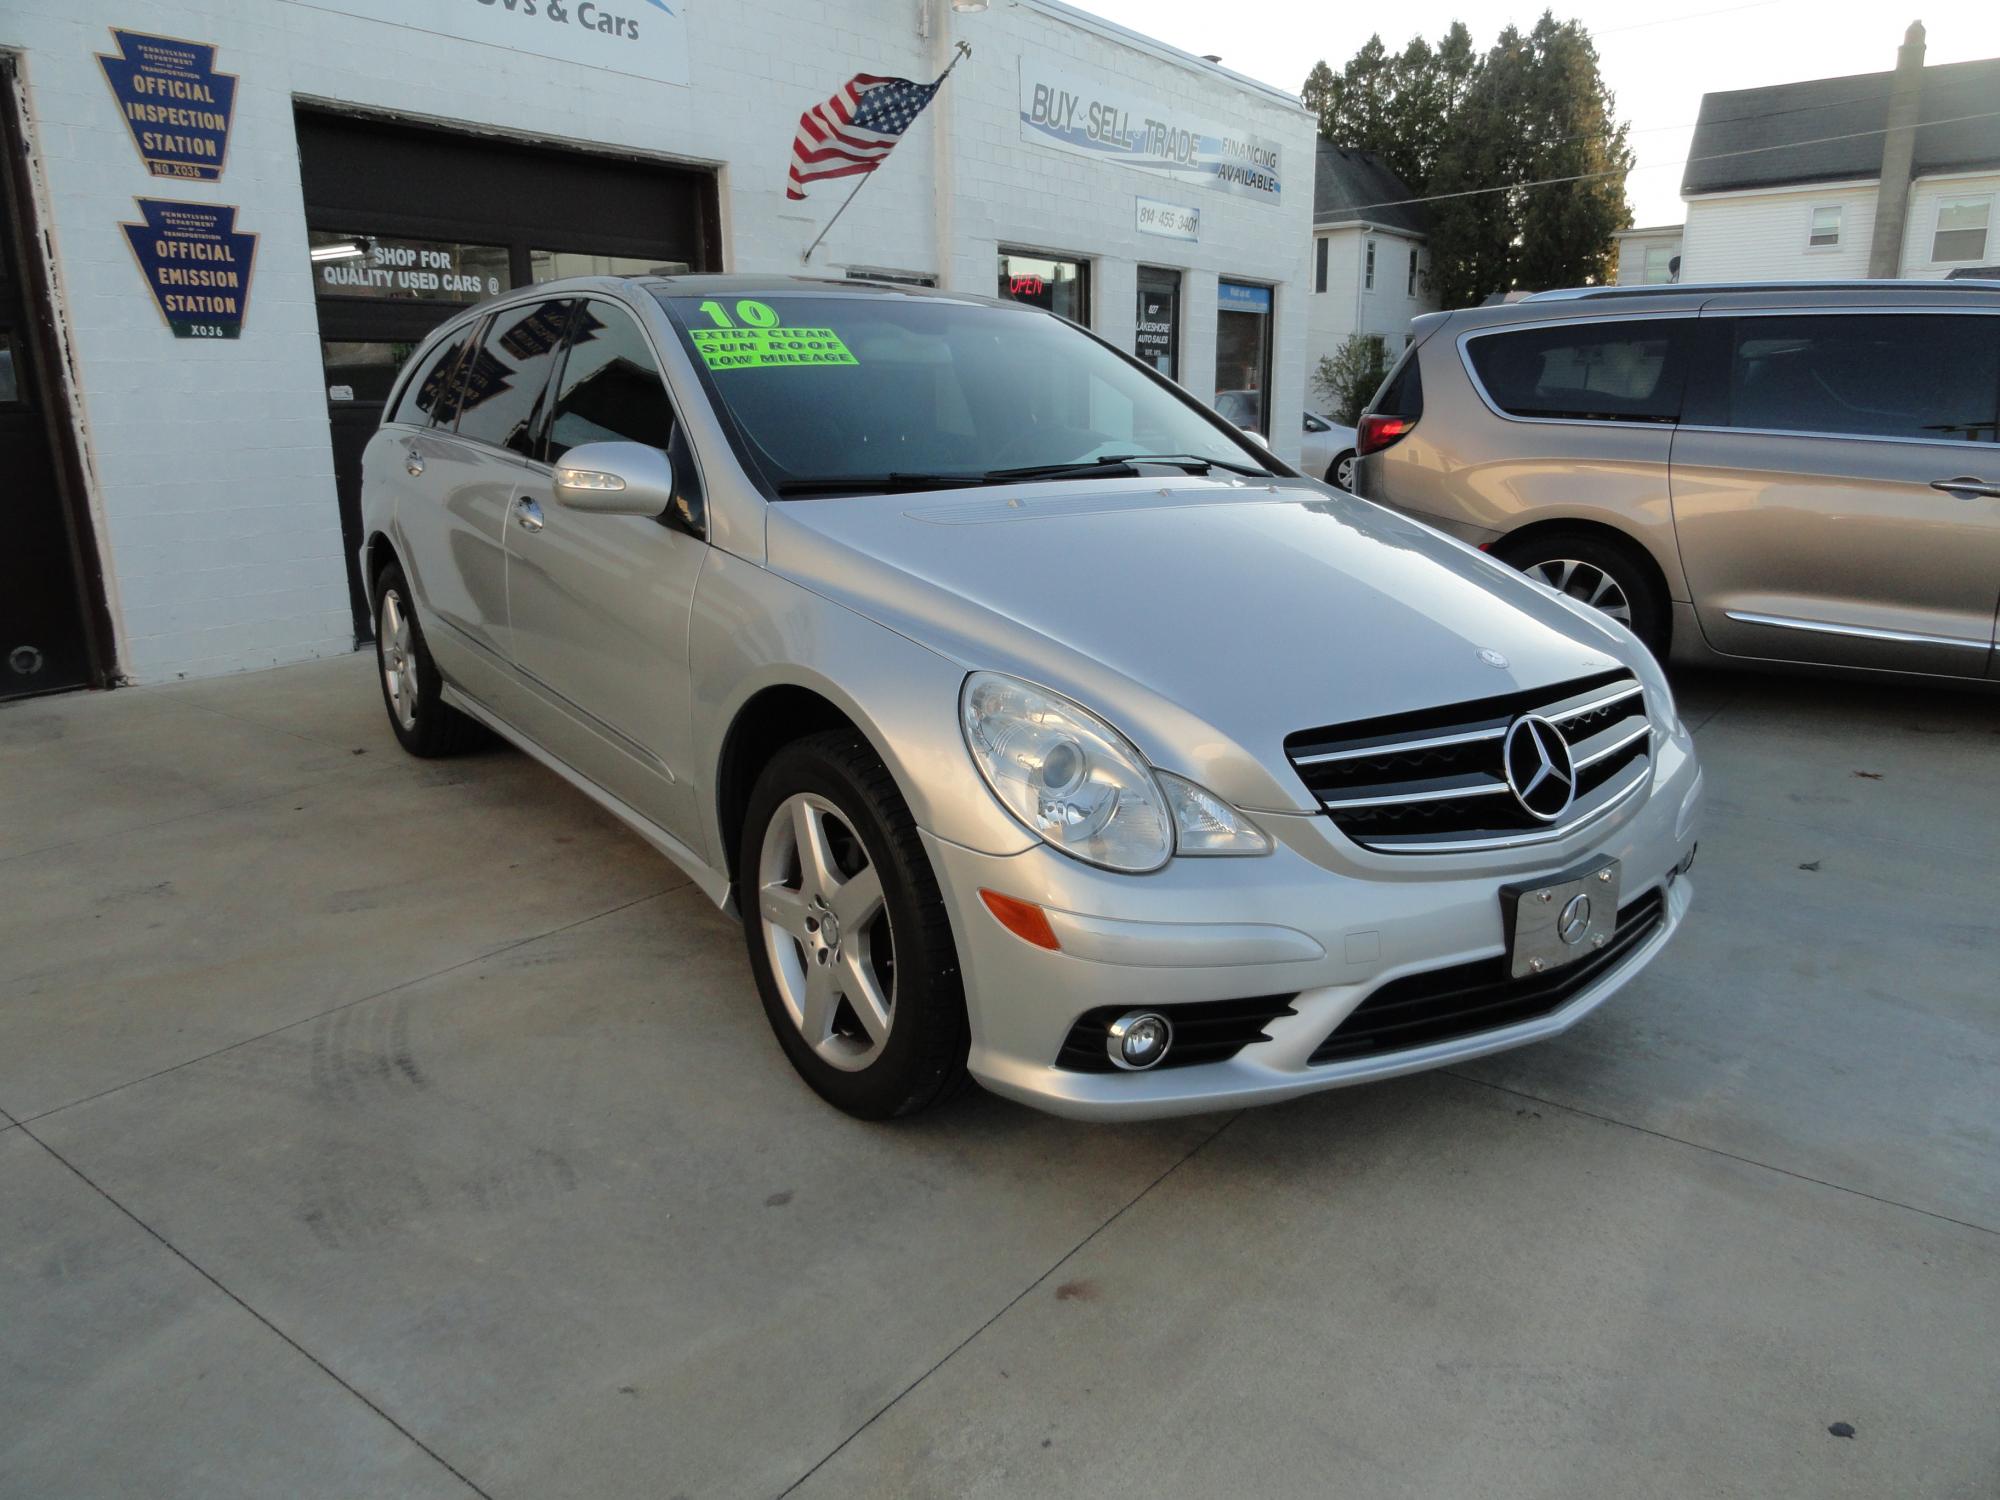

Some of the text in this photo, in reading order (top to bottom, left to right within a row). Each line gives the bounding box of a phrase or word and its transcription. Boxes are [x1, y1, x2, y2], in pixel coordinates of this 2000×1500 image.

[577, 2, 639, 41] Cars
[137, 44, 196, 60] PENNSYLVANIA
[143, 53, 194, 66] DEPARTMENT
[141, 65, 200, 79] TRANSPORTATION
[133, 74, 215, 103] OFFICIAL
[127, 102, 226, 131] INSPECTION
[1031, 83, 1201, 167] BUY SELL TRADE
[143, 132, 217, 157] STATION
[1222, 138, 1277, 168] FINANCING
[174, 165, 201, 177] X036
[1218, 163, 1276, 193] AVAILABLE
[161, 211, 218, 221] PENNSYLVANIA
[166, 218, 215, 228] DEPARTMENT
[163, 231, 222, 240] TRANSPORTATION
[156, 240, 236, 262] OFFICIAL
[375, 248, 451, 269] SHOP FOR
[158, 267, 239, 288] EMISSION
[323, 266, 499, 296] QUALITY USED CARS @
[1010, 273, 1044, 295] OPEN
[165, 294, 237, 314] STATION
[700, 300, 779, 328] 10
[191, 325, 223, 337] X036
[693, 329, 831, 341] EXTRA CLEAN
[1136, 321, 1171, 333] LAKESHORE
[702, 341, 841, 353] SUN ROOF
[1137, 334, 1169, 344] AUTO SALES
[707, 353, 851, 366] LOW MILEAGE
